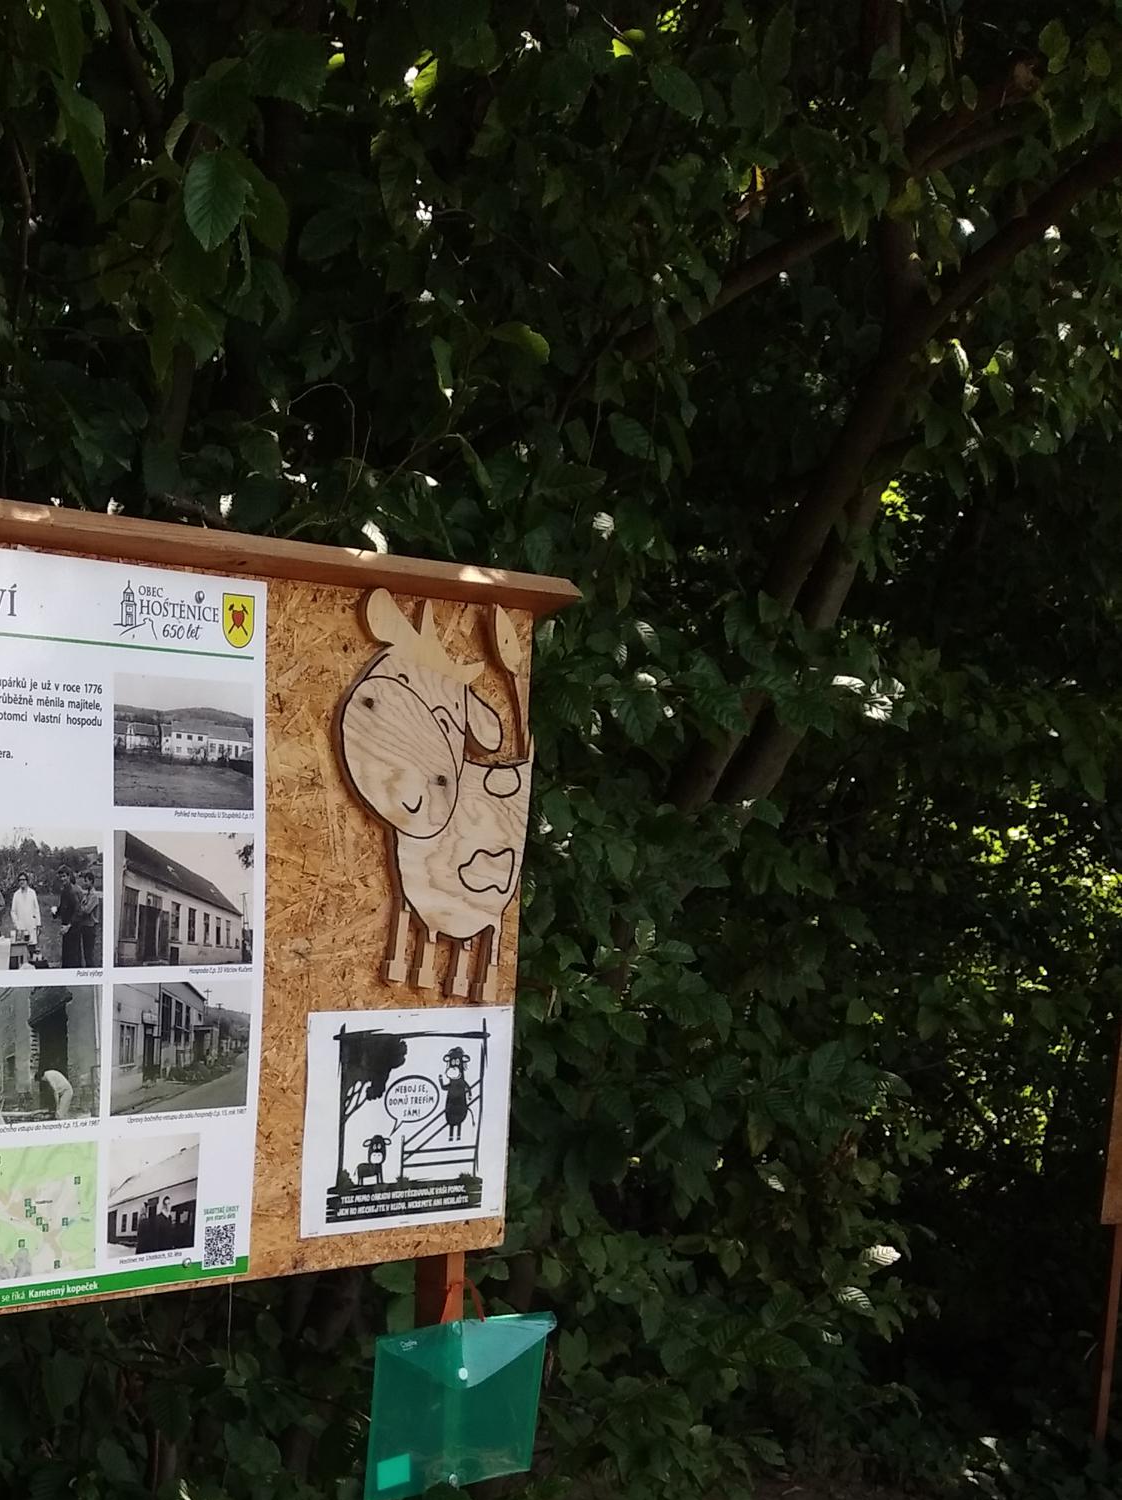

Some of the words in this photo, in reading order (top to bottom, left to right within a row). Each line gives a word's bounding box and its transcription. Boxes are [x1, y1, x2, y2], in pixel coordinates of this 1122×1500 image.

[138, 585, 163, 597] OBEC
[139, 599, 219, 623] HOSTĚNICE
[162, 624, 184, 639] 650
[187, 626, 203, 640] let
[30, 680, 37, 691] je
[41, 680, 51, 690] už
[63, 684, 80, 692] roce
[85, 684, 102, 694] 1776
[36, 696, 64, 708] měnila
[68, 698, 102, 711] majitele,
[33, 713, 60, 724] vlastní
[67, 715, 102, 727] hospodu
[29, 1287, 65, 1298] Kamenný
[67, 1282, 98, 1294] kopeček
